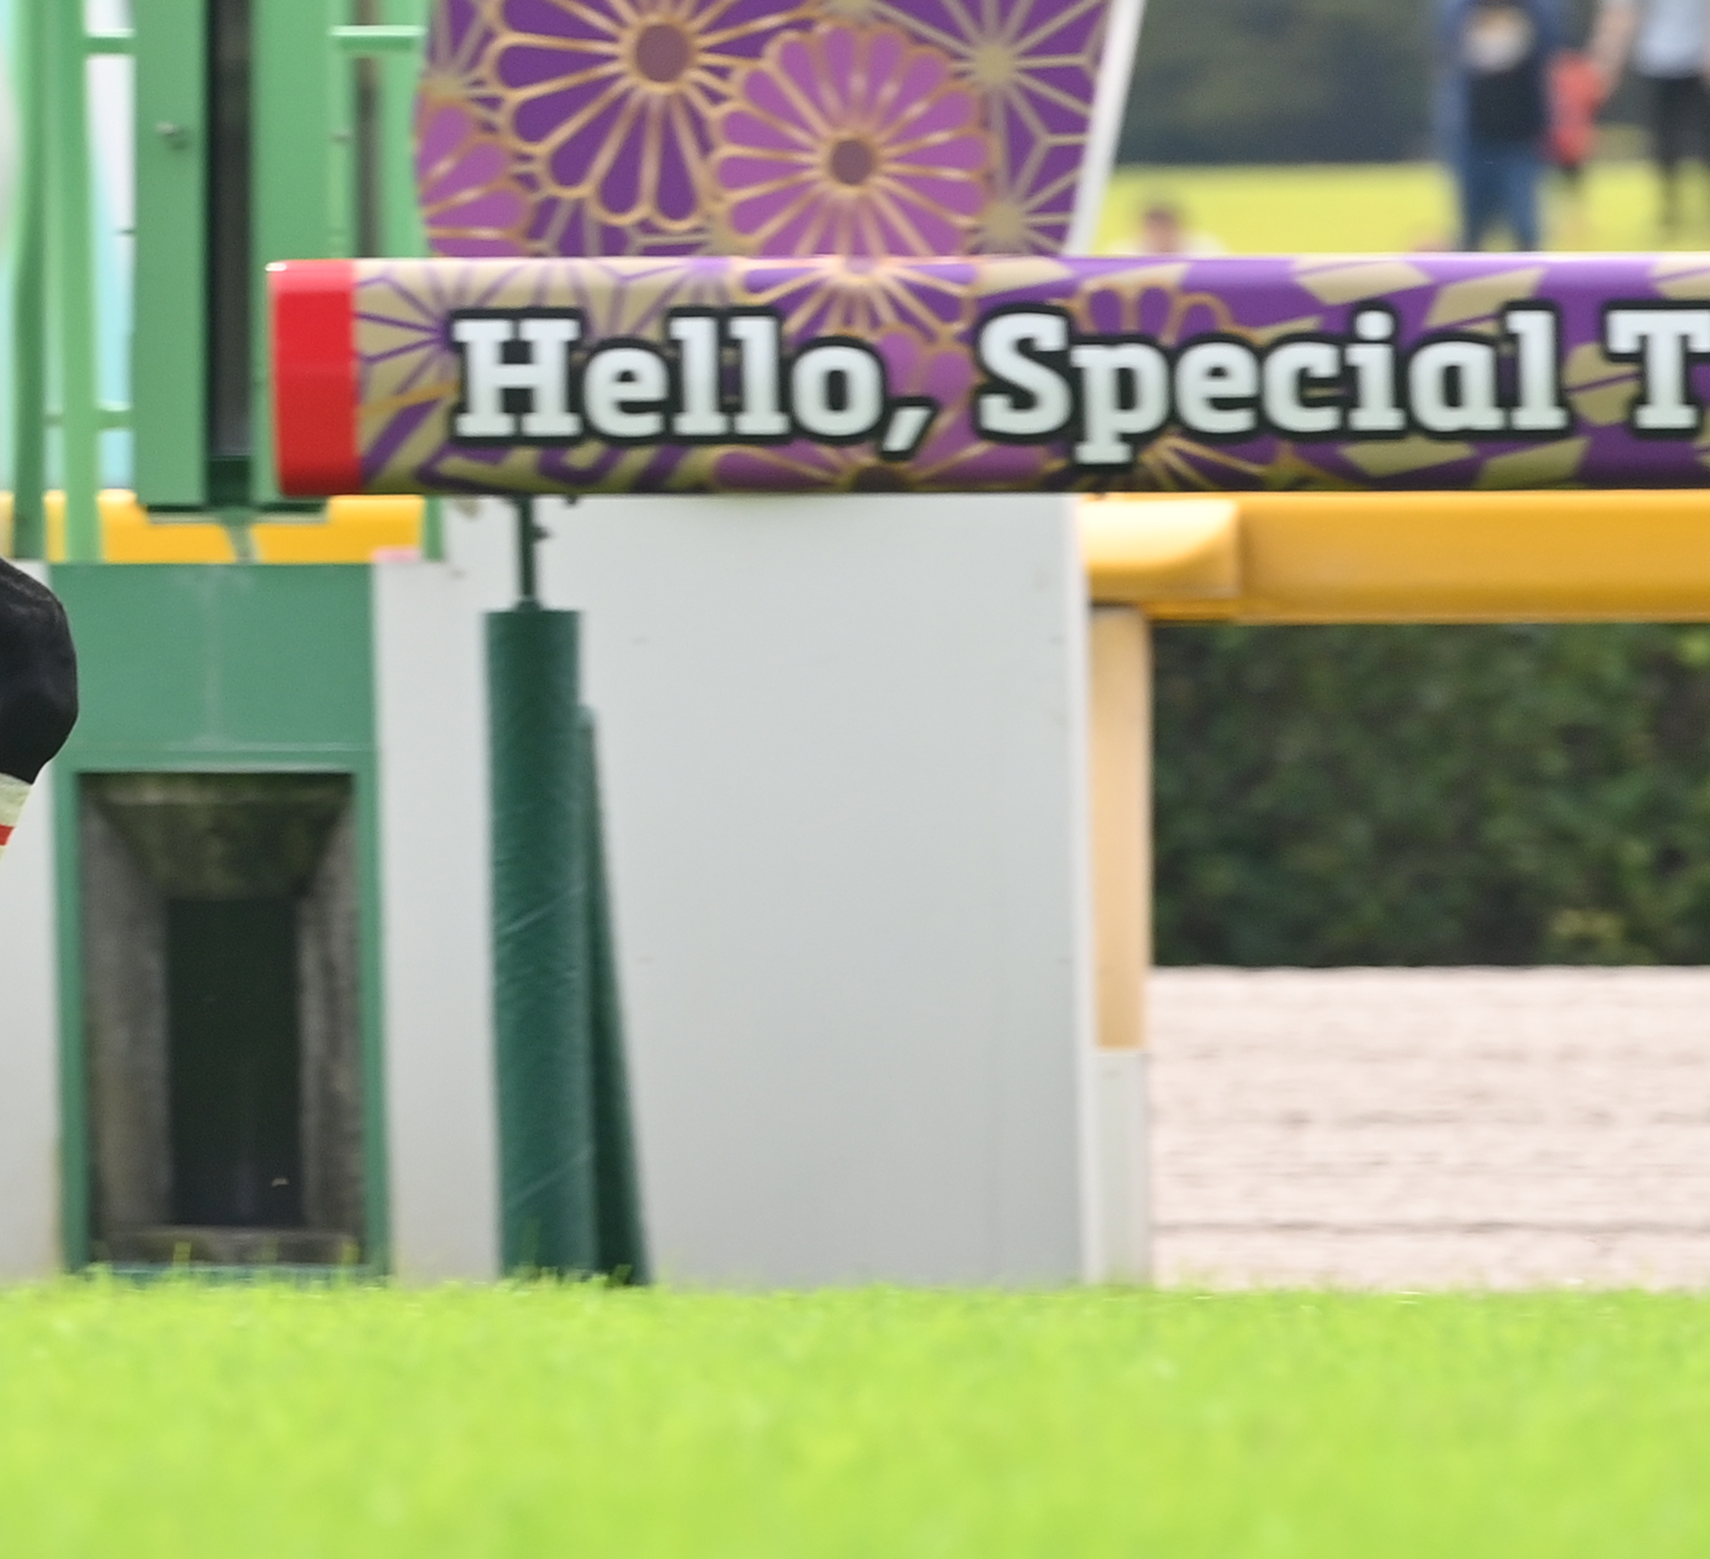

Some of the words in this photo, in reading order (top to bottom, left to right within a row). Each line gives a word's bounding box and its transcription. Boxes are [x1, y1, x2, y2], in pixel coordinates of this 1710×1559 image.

[450, 315, 934, 455] Hello,
[977, 307, 1570, 466] Special
[1604, 308, 1710, 431] T
